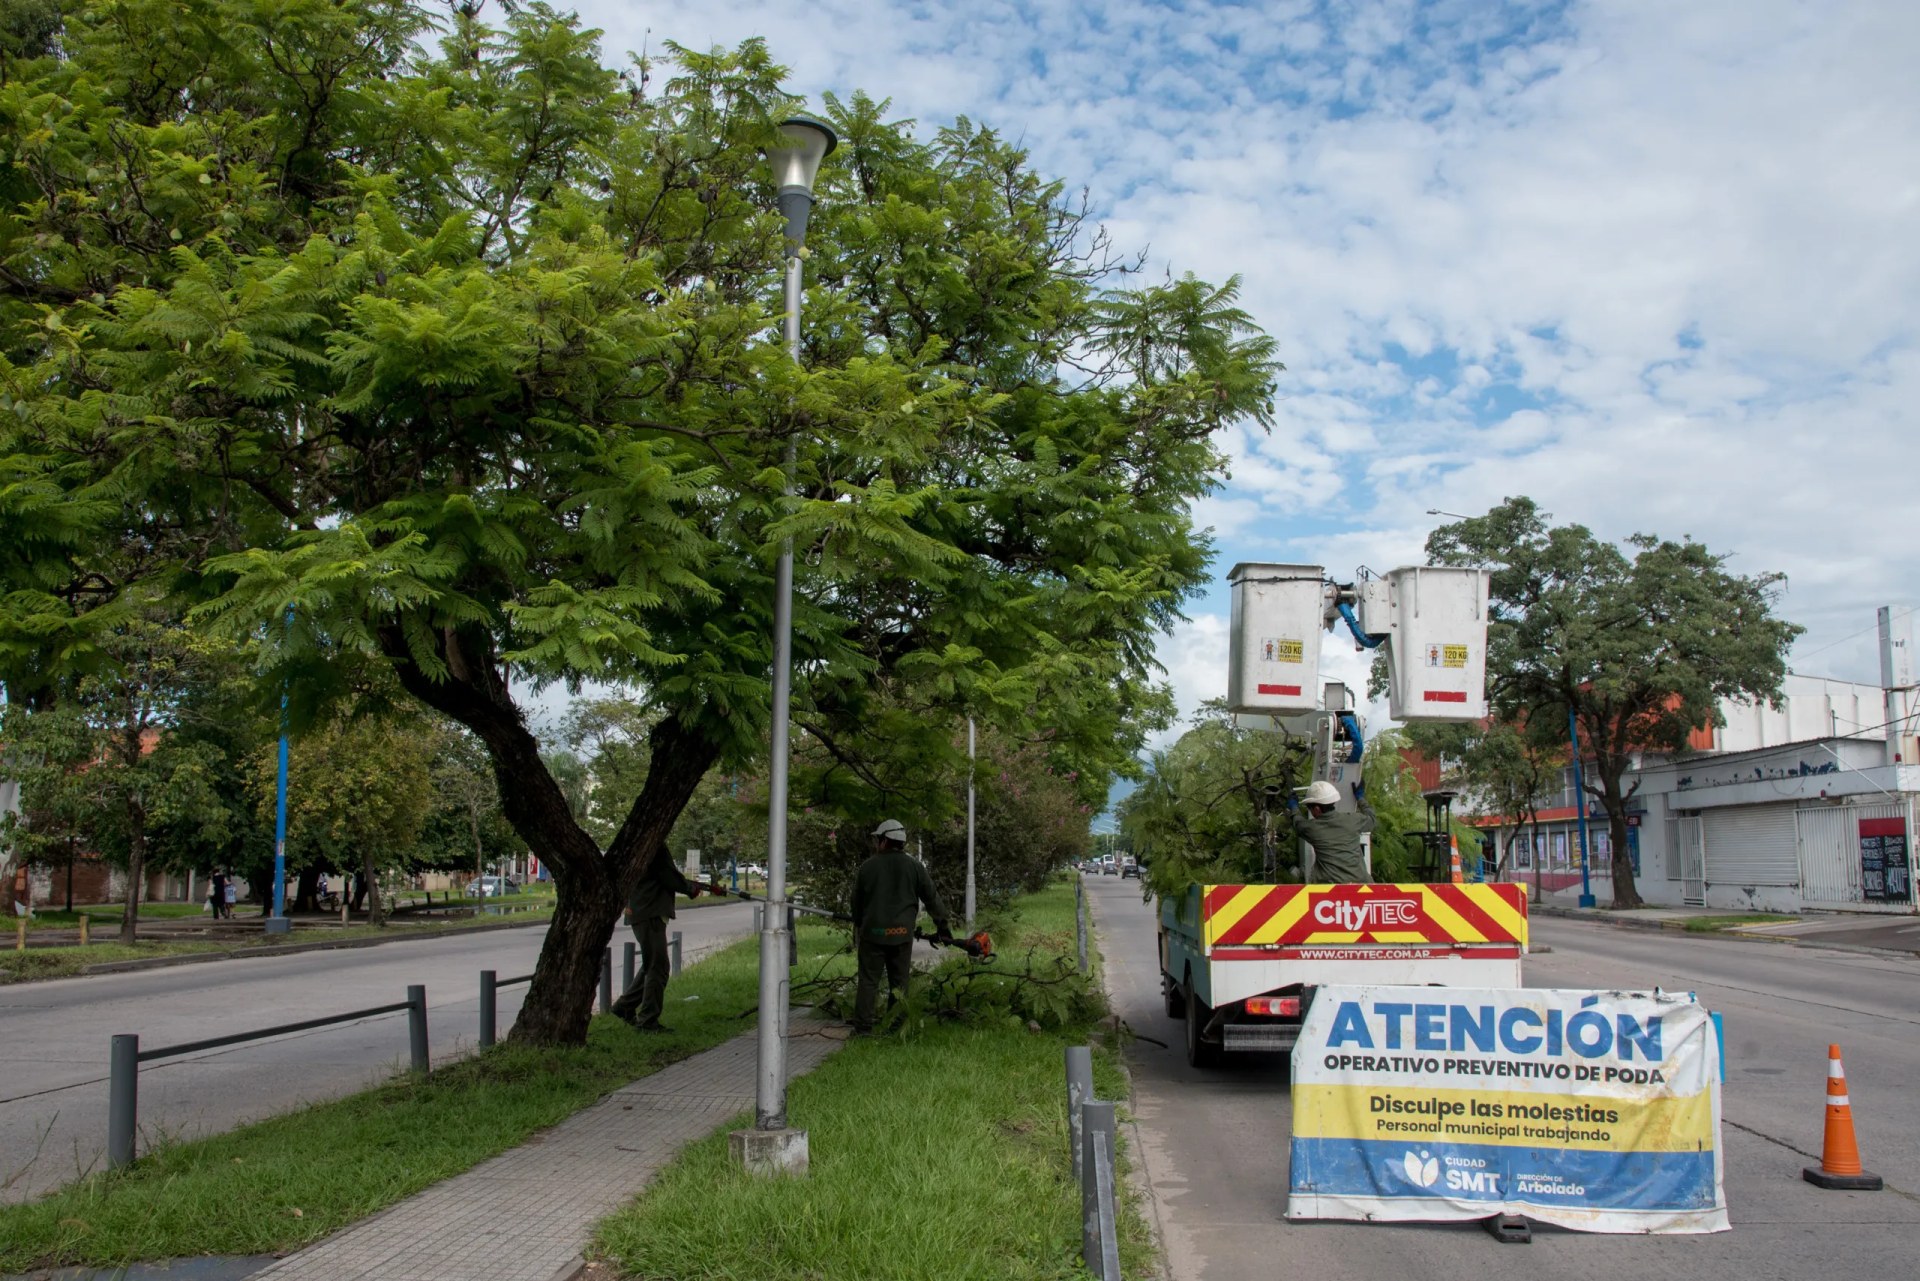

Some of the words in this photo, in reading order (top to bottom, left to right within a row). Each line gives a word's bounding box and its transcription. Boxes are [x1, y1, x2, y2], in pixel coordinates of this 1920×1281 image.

[1279, 645, 1292, 654] 120
[1293, 645, 1303, 655] KG
[1444, 650, 1457, 660] 120
[1458, 650, 1467, 660] KG
[1300, 949, 1431, 959] WWW.CITYTEC.COM.AR
[1325, 994, 1664, 1062] ATENCIÓN
[1324, 1054, 1440, 1074] OPERATIVO
[1443, 1058, 1571, 1079] PREVENTIVO
[1575, 1065, 1601, 1081] DE
[1604, 1066, 1665, 1085] PODA
[1370, 1093, 1466, 1121] Disculpe
[1470, 1098, 1504, 1118] las
[1507, 1102, 1619, 1124] molestias
[1376, 1119, 1442, 1133] Personal
[1445, 1122, 1520, 1140] municipal
[1523, 1125, 1611, 1143] trabajando
[1445, 1156, 1486, 1168] CIUDAD
[1445, 1169, 1501, 1194] SMT
[1516, 1172, 1553, 1182] DIRECCIÓN
[1516, 1180, 1585, 1196] Arbolado
